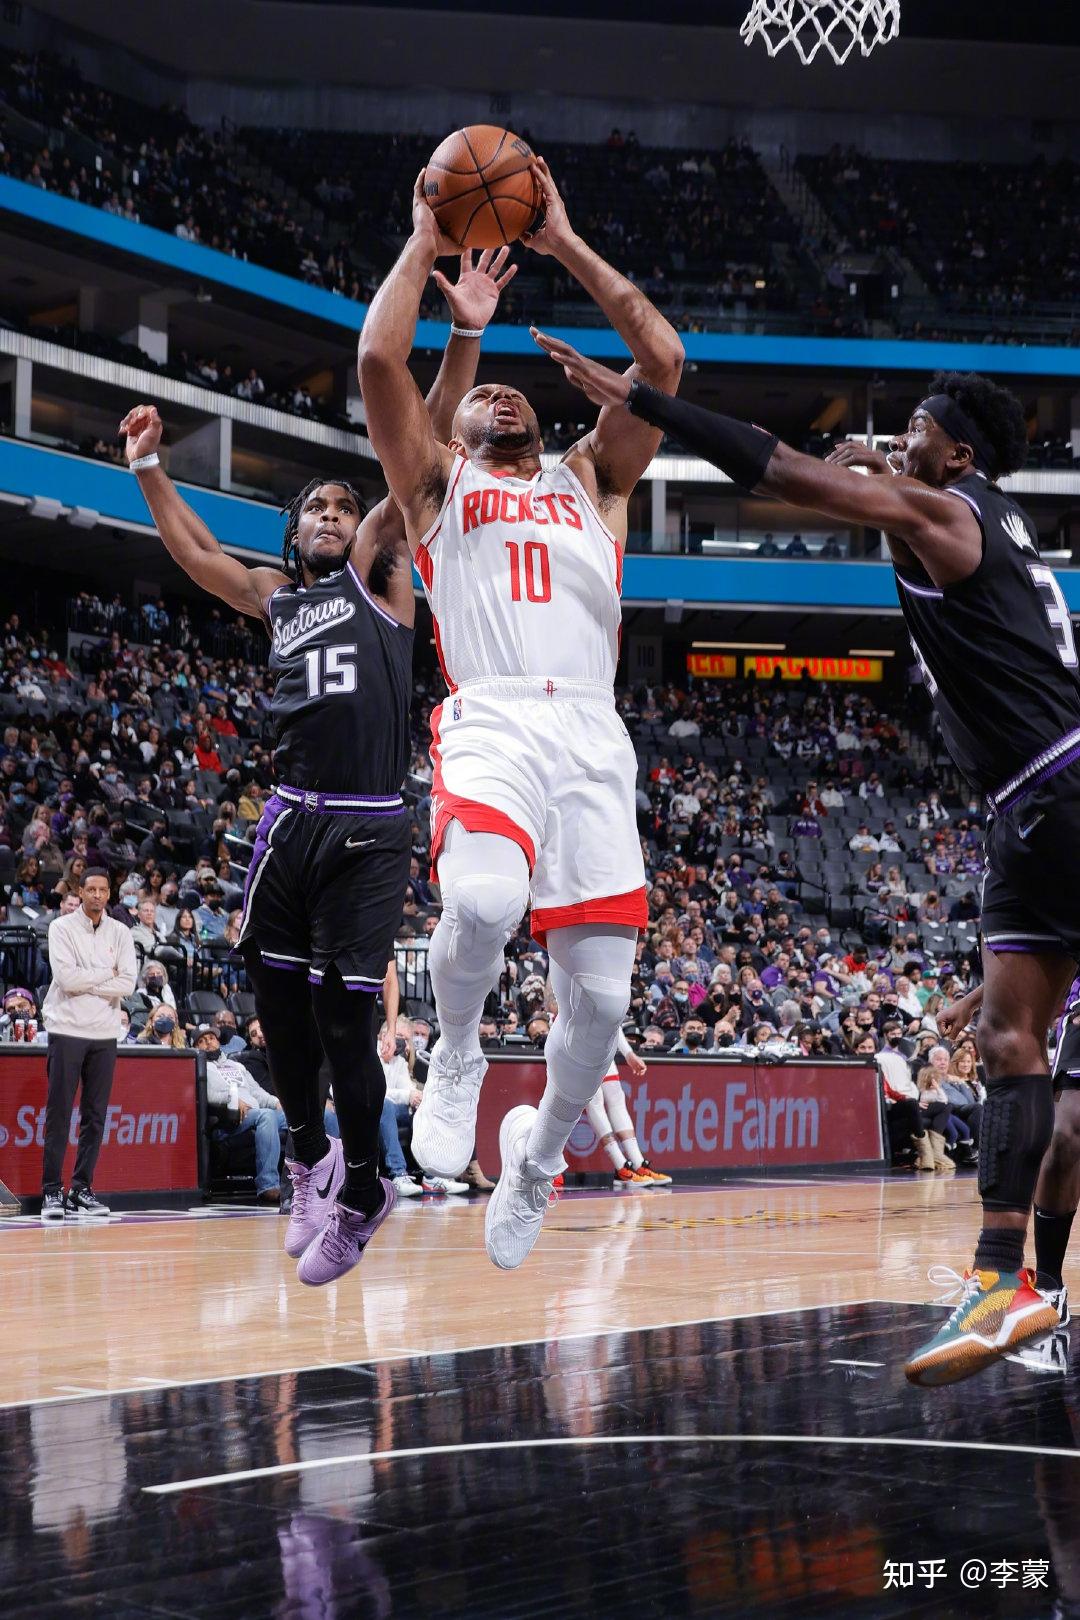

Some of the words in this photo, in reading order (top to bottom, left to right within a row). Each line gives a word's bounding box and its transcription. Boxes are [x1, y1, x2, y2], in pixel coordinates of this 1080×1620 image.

[462, 488, 582, 535] ROCKETS
[505, 541, 552, 603] 10
[273, 596, 356, 658] Sactown
[304, 643, 358, 700] 15
[687, 654, 725, 673] ER
[14, 1104, 82, 1147] Stt
[101, 1104, 179, 1146] Farm
[625, 1083, 719, 1154] tate
[723, 1081, 820, 1152] Farm
